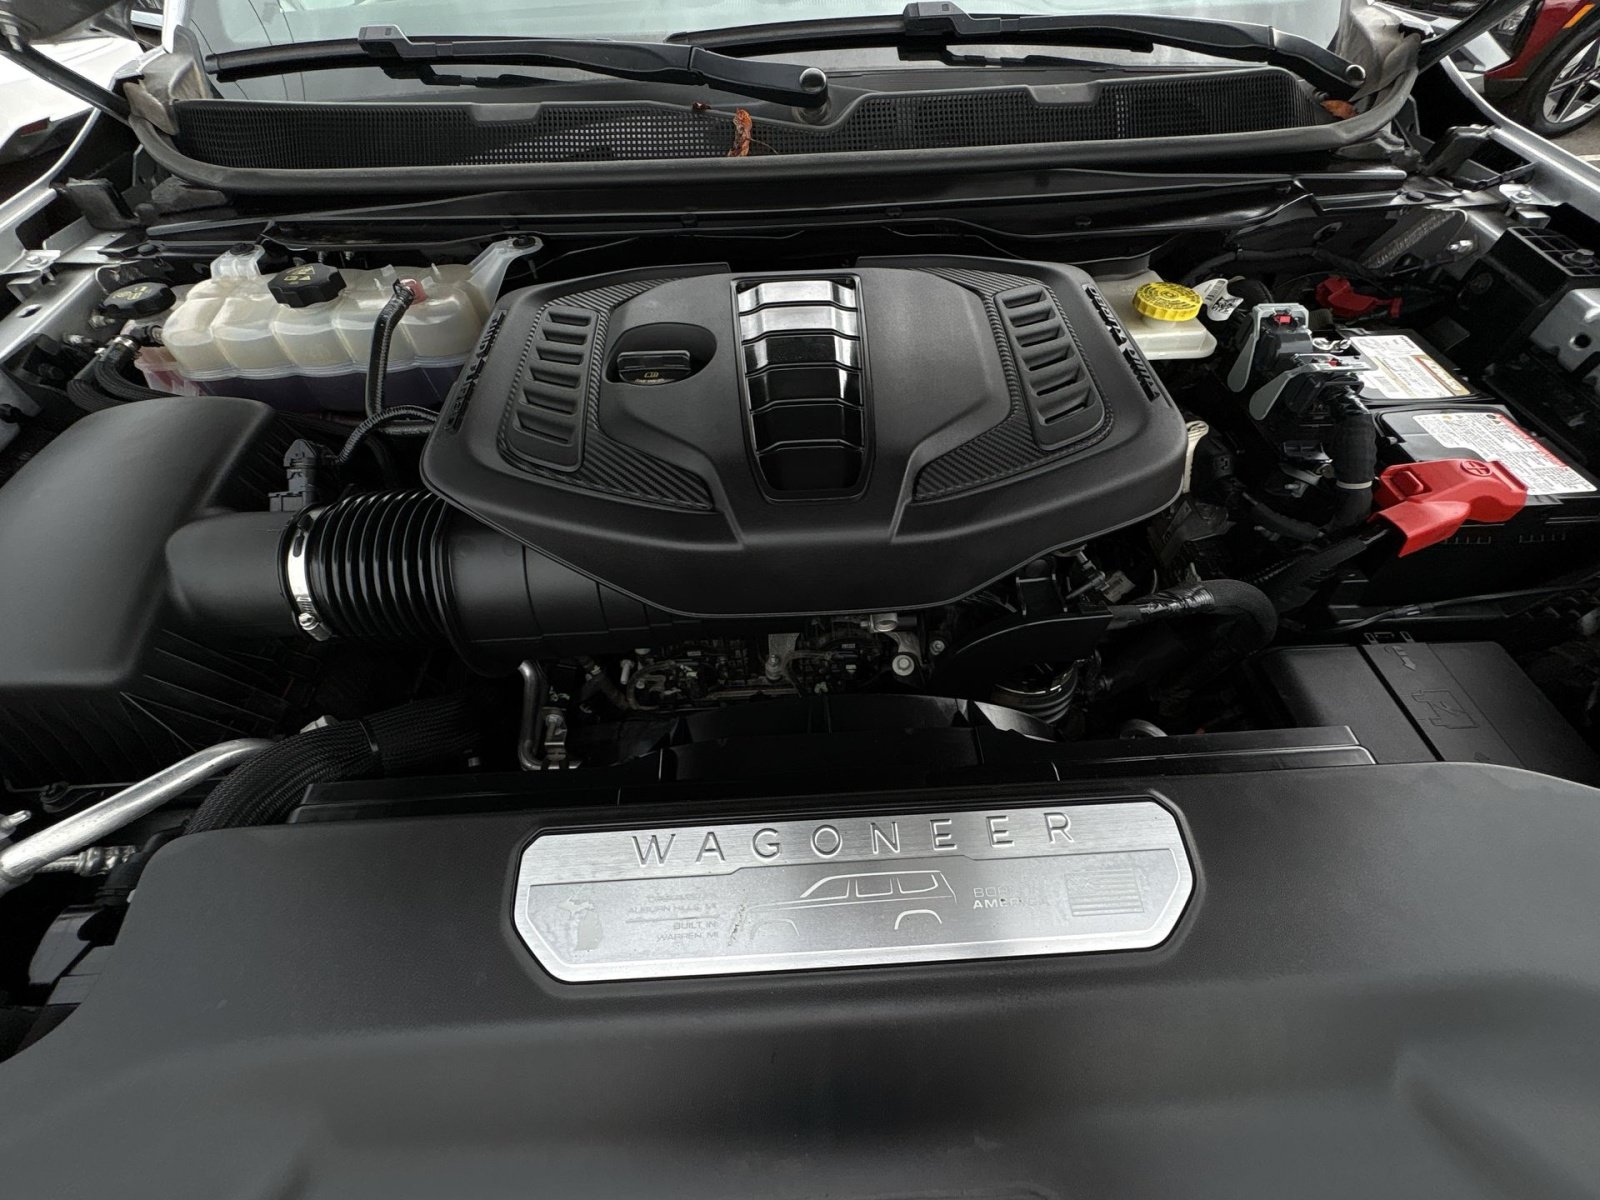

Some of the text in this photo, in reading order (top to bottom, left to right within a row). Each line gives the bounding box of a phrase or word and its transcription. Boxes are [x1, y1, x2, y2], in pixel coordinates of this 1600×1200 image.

[1084, 286, 1160, 402] TWIN TURBO
[631, 811, 1074, 867] WAGONEER
[673, 921, 702, 930] BUILT
